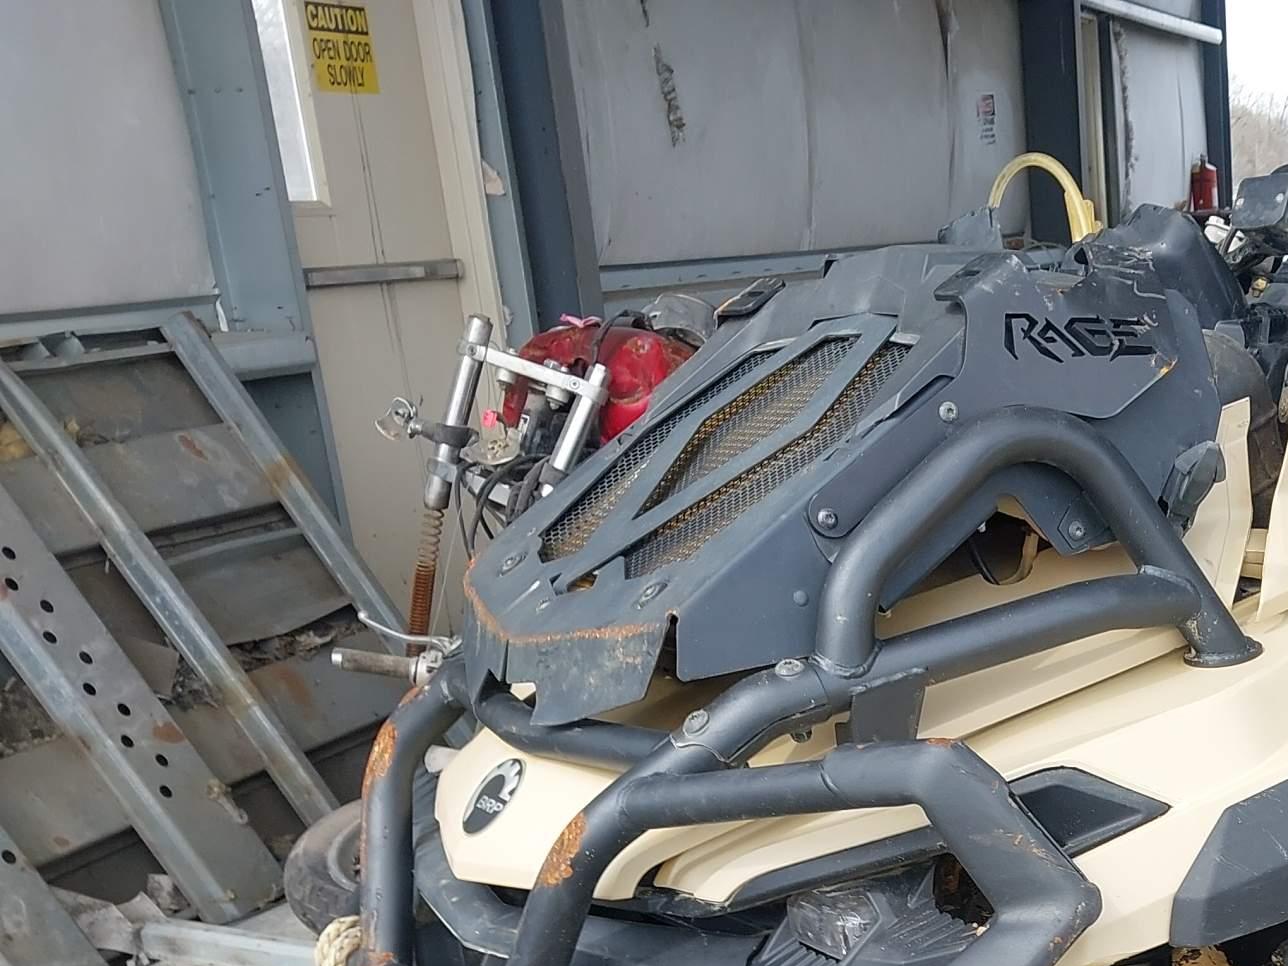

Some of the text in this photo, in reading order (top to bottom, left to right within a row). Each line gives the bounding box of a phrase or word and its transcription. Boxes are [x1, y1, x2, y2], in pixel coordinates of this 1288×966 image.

[306, 3, 368, 32] CAUTION
[312, 37, 373, 63] OPEN DOOR
[327, 63, 365, 87] SLOWLY
[1003, 312, 1158, 364] RAGE
[475, 794, 504, 815] BRP
